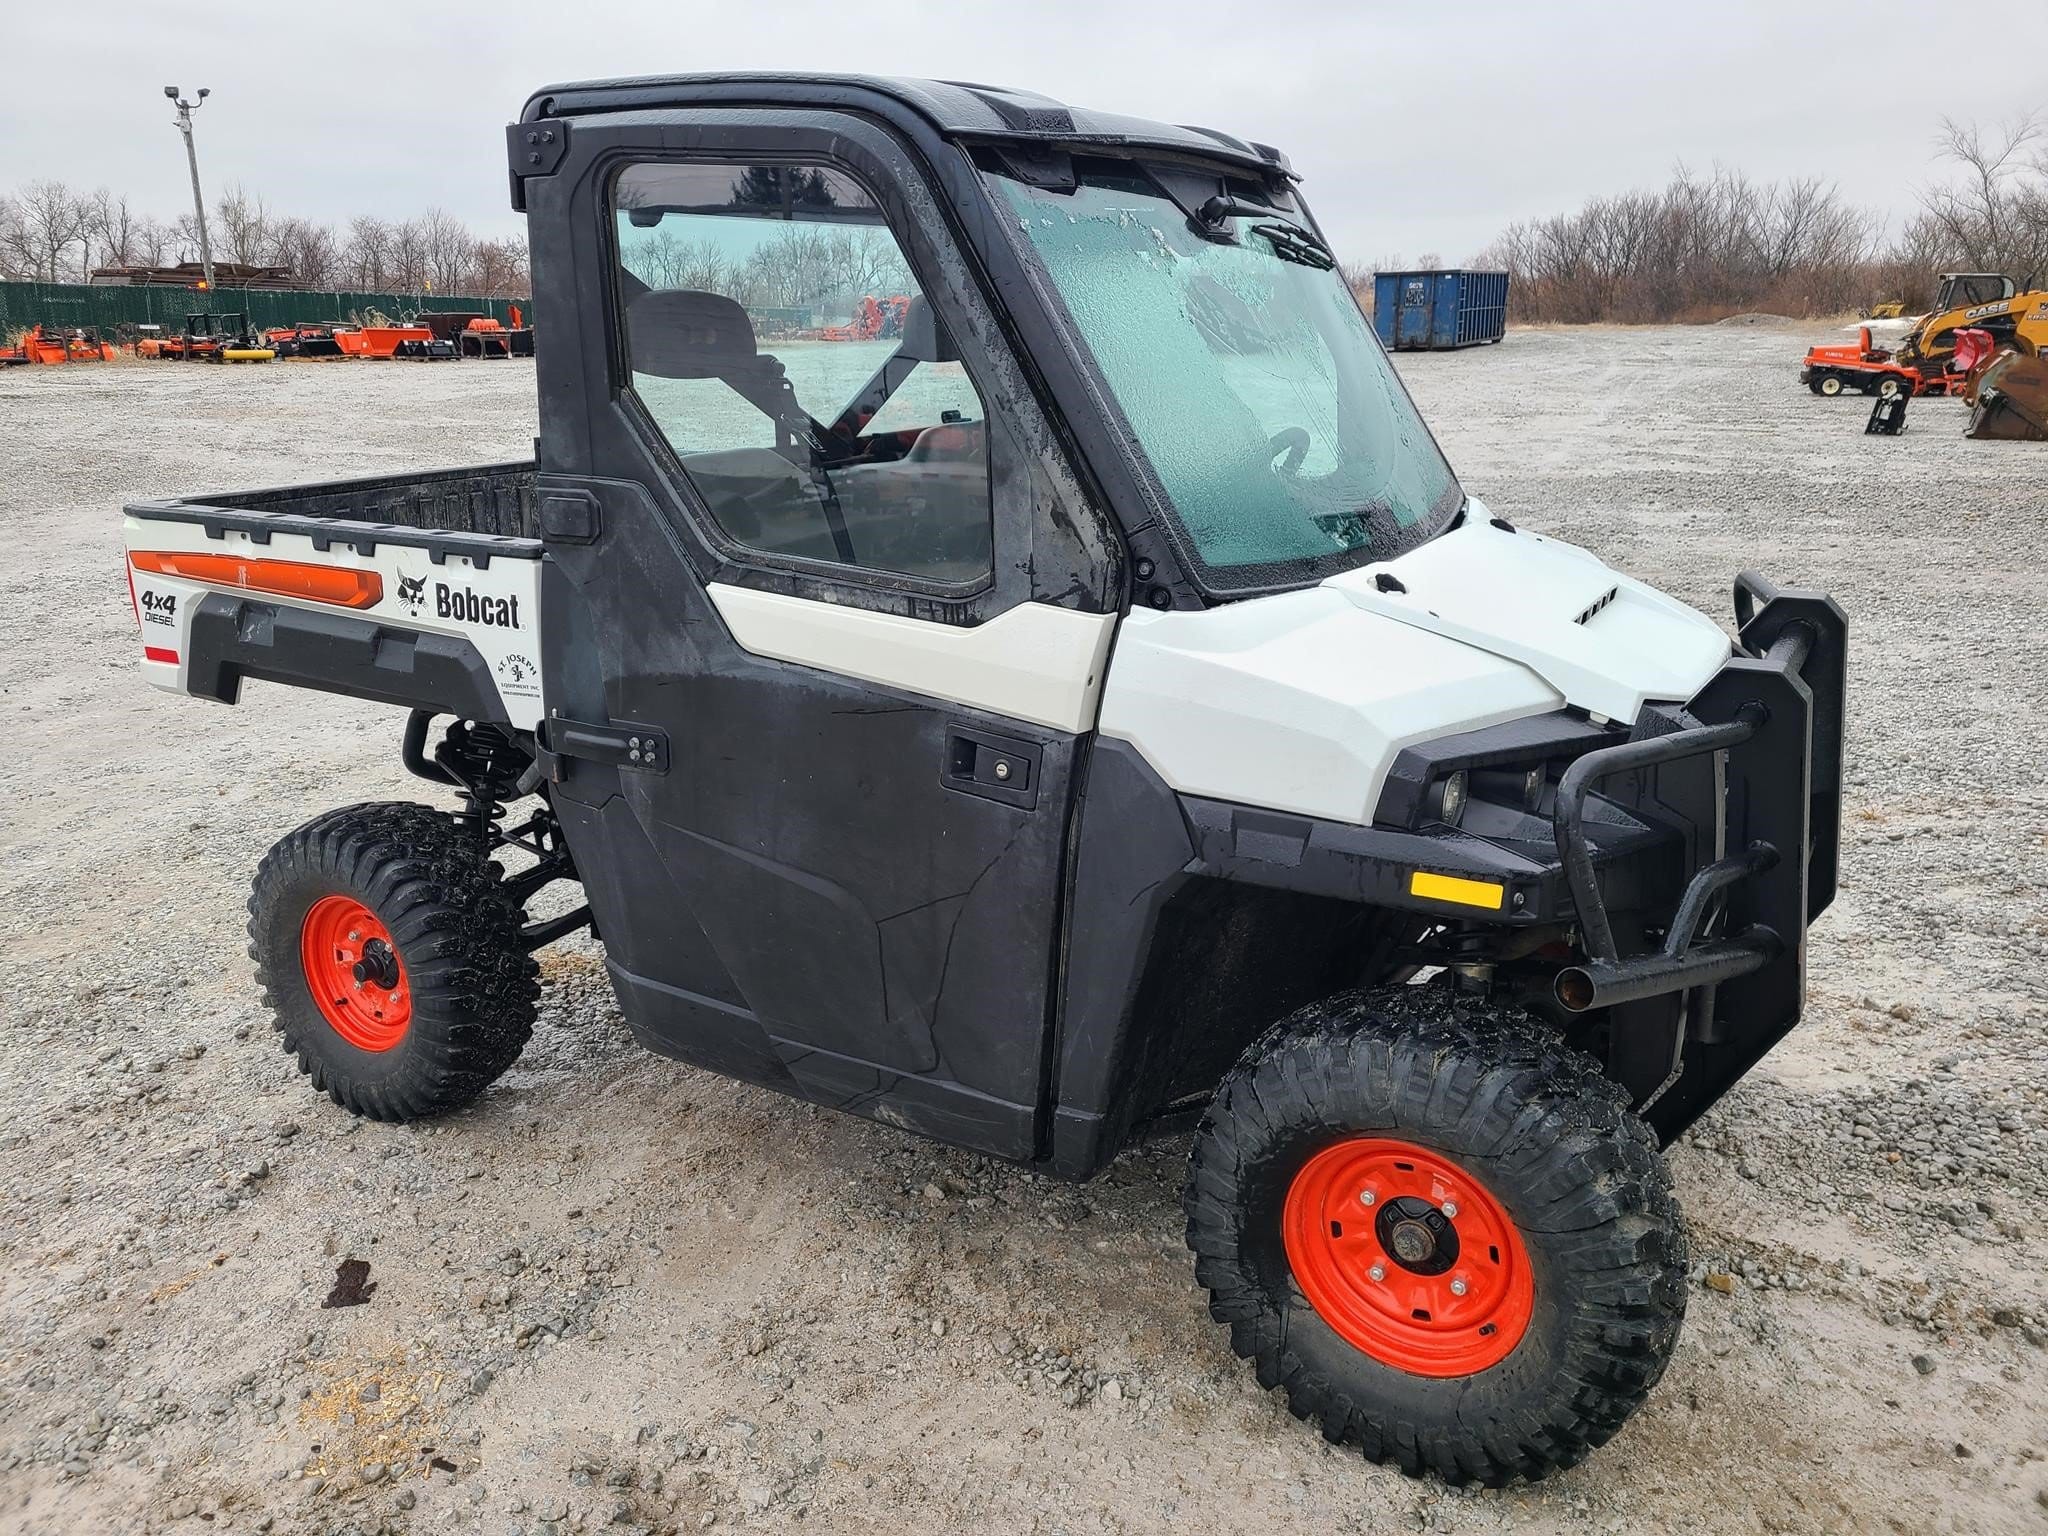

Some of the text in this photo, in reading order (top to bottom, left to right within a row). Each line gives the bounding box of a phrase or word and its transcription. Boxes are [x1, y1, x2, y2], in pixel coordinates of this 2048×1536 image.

[1965, 302, 2010, 319] CASE
[141, 590, 176, 615] 4x4
[435, 582, 519, 629] Bobcat
[144, 612, 175, 627] DIESEL
[506, 654, 537, 676] JOSEPH
